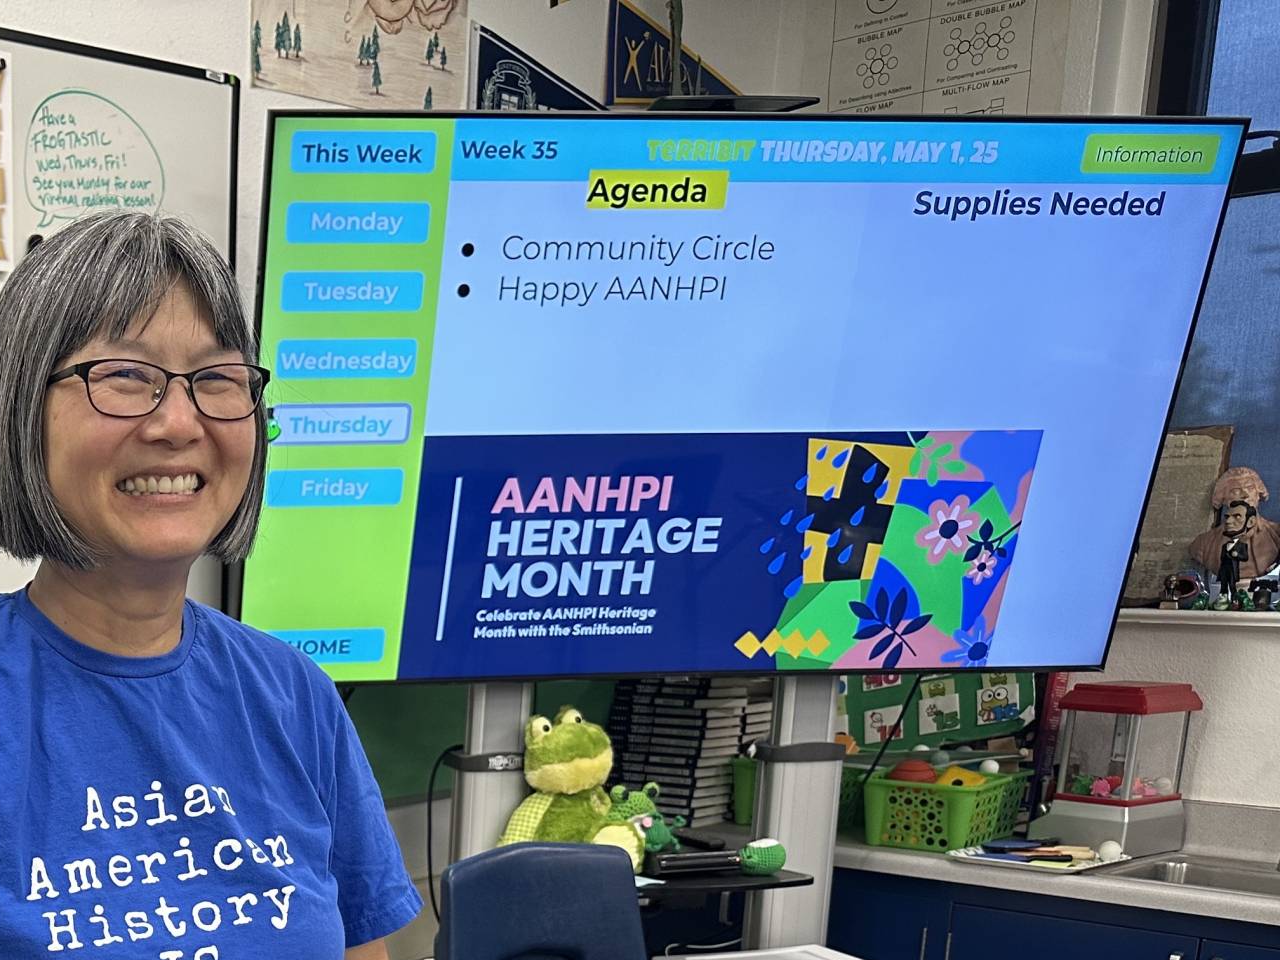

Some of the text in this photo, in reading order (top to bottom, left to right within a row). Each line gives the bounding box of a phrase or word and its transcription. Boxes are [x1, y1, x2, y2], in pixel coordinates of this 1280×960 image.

[940, 1, 1025, 24] DOUBLE BUBBLE MAP
[857, 28, 904, 44] BUBBLE MAP
[942, 76, 1010, 96] MULTI-FLOW MAP
[39, 106, 77, 126] Have a
[878, 100, 894, 111] MAP
[32, 129, 112, 152] FROGTASTIC
[461, 140, 558, 160] Week 35
[66, 154, 102, 171] Thurs,
[302, 144, 423, 164] This Week
[760, 140, 886, 165] THURSDAY,
[892, 140, 945, 164] MAY
[949, 140, 966, 166] 1,
[970, 140, 999, 164] 25
[1096, 145, 1204, 164] Information
[32, 176, 151, 195] See you Monday for our
[586, 176, 708, 210] Agenda
[914, 190, 1165, 221] Supplies Needed
[310, 212, 404, 237] Monday
[502, 236, 776, 266] Community Circle
[304, 281, 400, 306] Tuesday
[498, 276, 727, 308] Happy AANHPI
[280, 350, 414, 373] Wednesday
[290, 416, 392, 439] Thursday
[301, 479, 370, 500] Friday
[490, 476, 674, 514] AANHPI
[486, 517, 722, 558] HERITAGE
[480, 560, 655, 600] MONTH
[476, 606, 656, 623] Celebrate AANHPI Heritage
[474, 622, 653, 639] Month with the Smithsonian
[933, 710, 960, 730] 15
[81, 780, 236, 832] Asian
[26, 834, 294, 901] American
[42, 884, 296, 952] History
